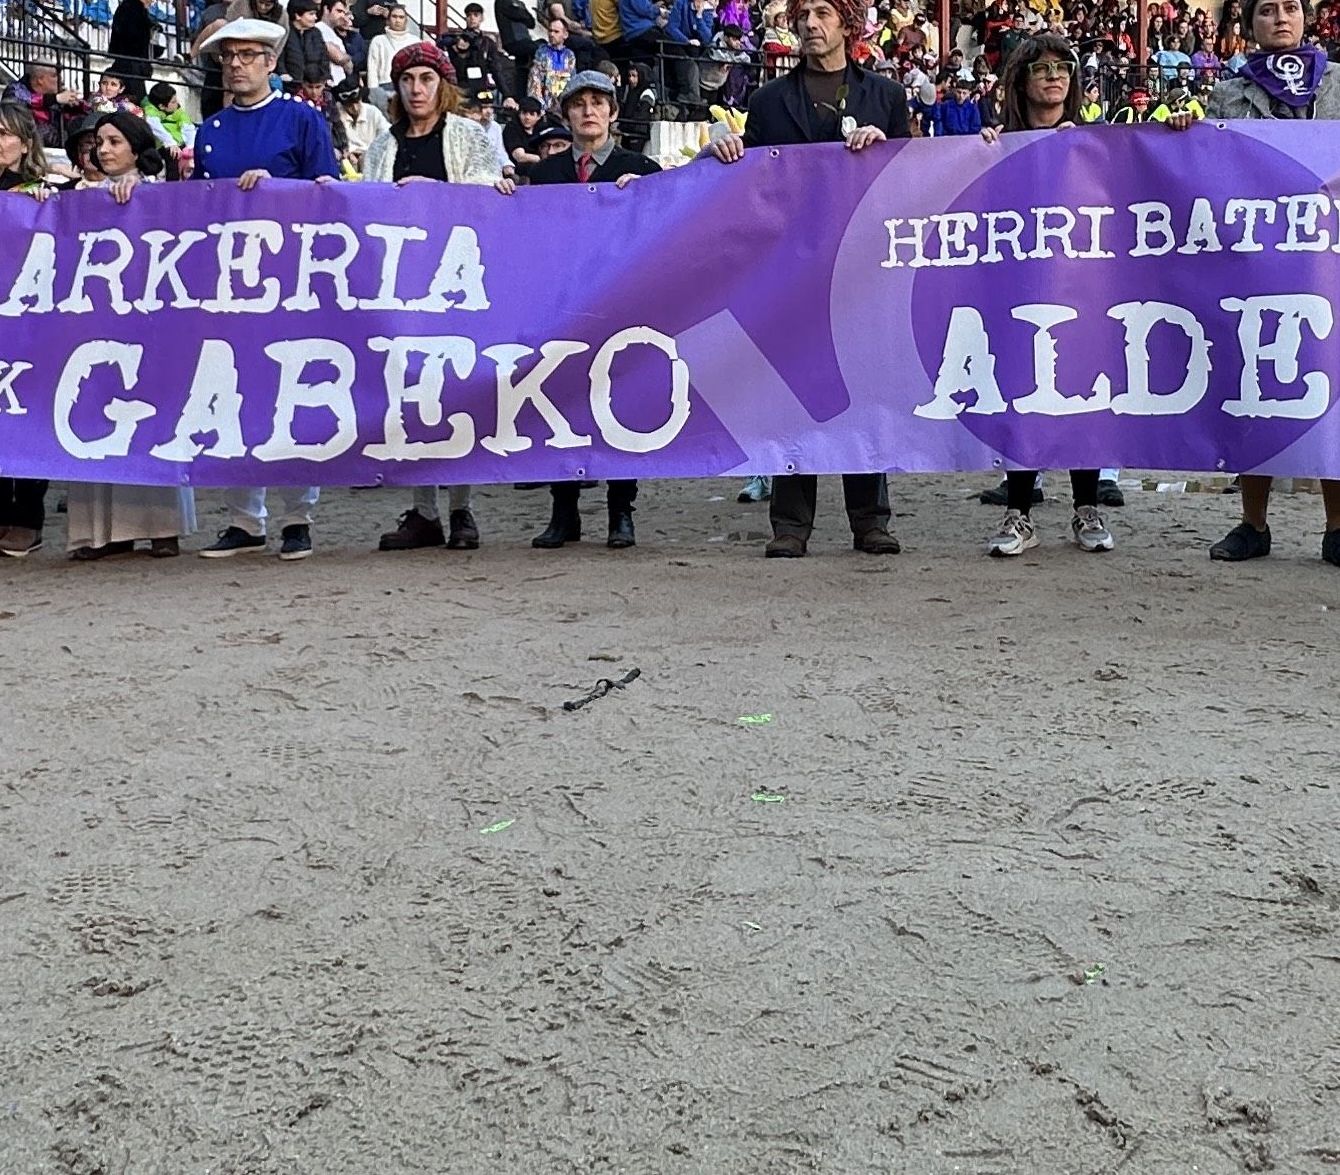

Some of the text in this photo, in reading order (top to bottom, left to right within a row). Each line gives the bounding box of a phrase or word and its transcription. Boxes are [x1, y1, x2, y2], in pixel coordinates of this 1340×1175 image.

[881, 207, 1116, 268] HERRI
[54, 325, 690, 461] GABEKO
[914, 294, 1334, 420] ALDE
